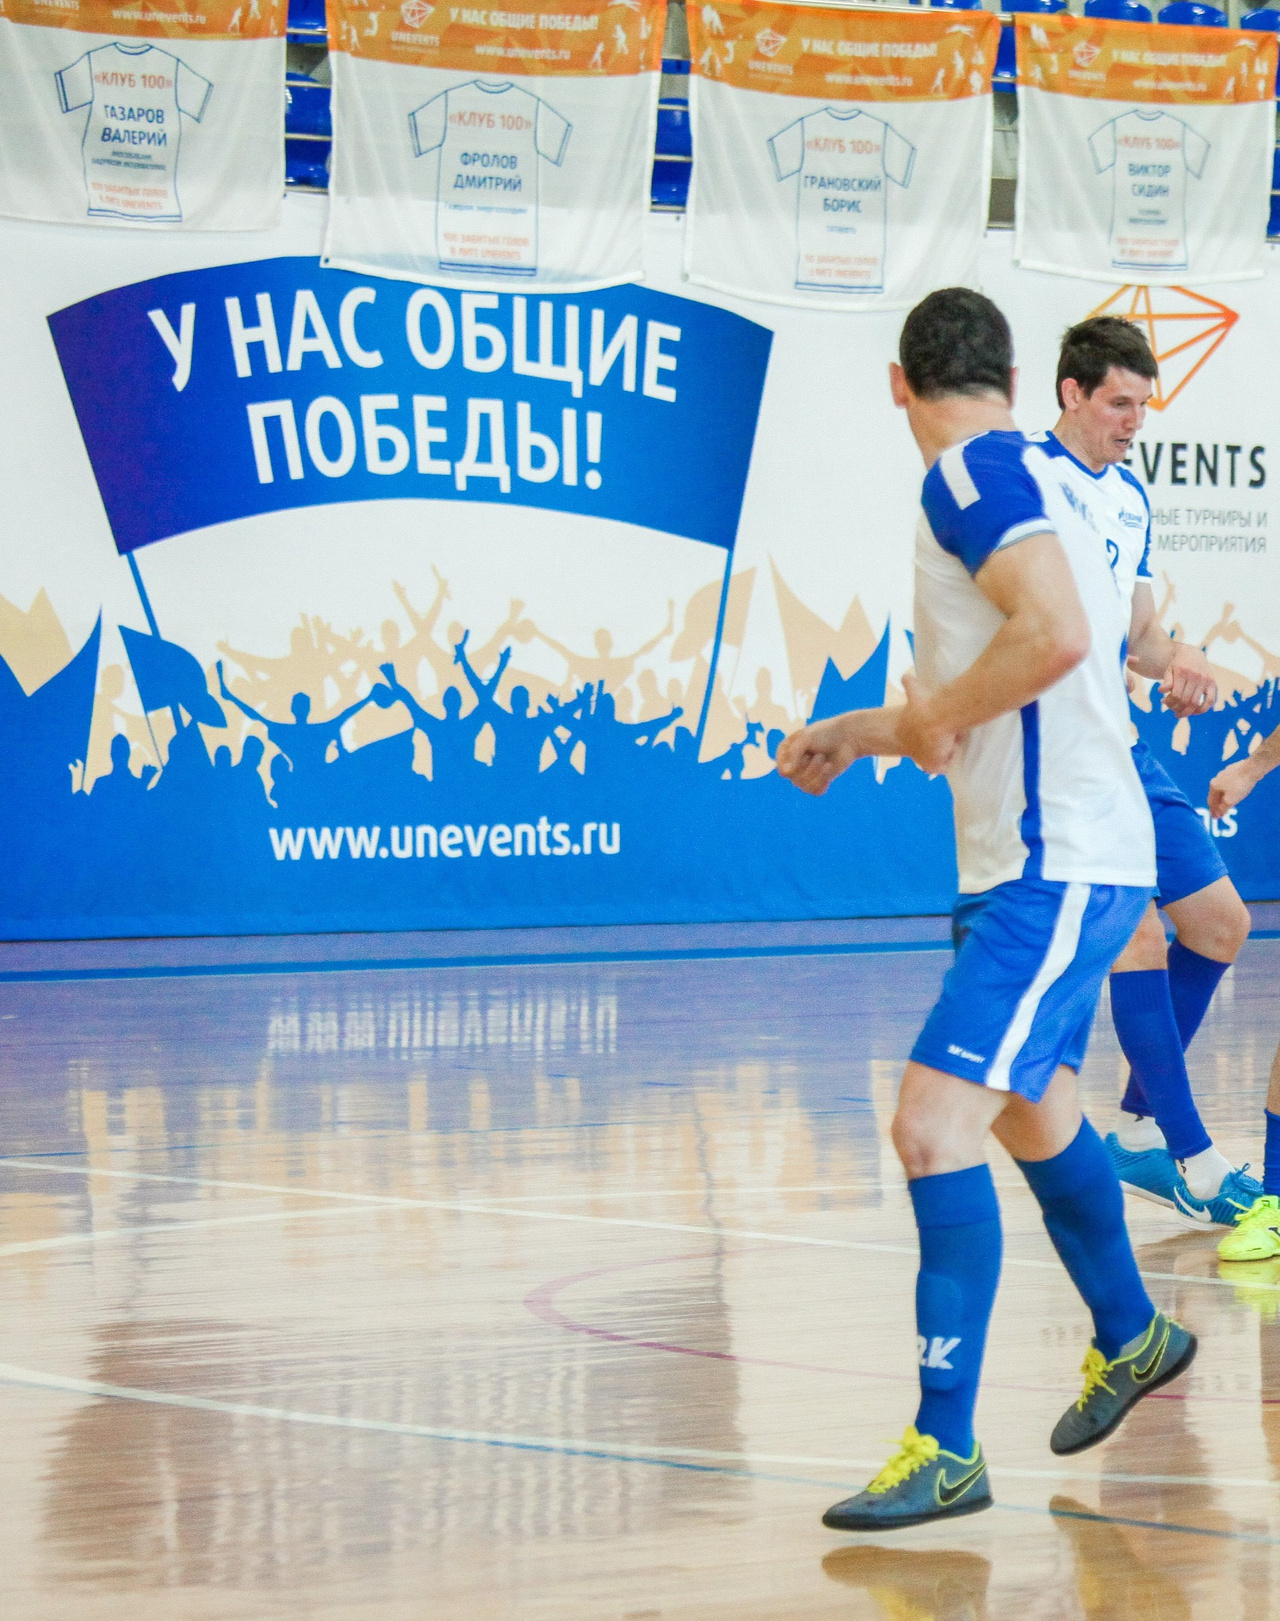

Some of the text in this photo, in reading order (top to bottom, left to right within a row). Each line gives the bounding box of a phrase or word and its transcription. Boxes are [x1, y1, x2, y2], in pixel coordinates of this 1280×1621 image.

[101, 126, 167, 147] ВАЛЕРИЙ
[461, 152, 518, 170] ФРОЛОВ
[1128, 163, 1171, 177] ВИКТОР
[454, 173, 522, 192] ДМИТРИЙ
[804, 174, 881, 192] ГРАНОВСКИЙ
[823, 198, 862, 213] БОРИС
[147, 287, 682, 403] У НАС ОБЩИЕ
[246, 393, 603, 493] ПОБЕДЫ!
[1185, 508, 1252, 528] ТУРНИРЫ
[1257, 511, 1268, 527] И
[1158, 533, 1267, 553] МЕРОПРИЯТИЯ
[269, 815, 621, 861] www.unevents.ru
